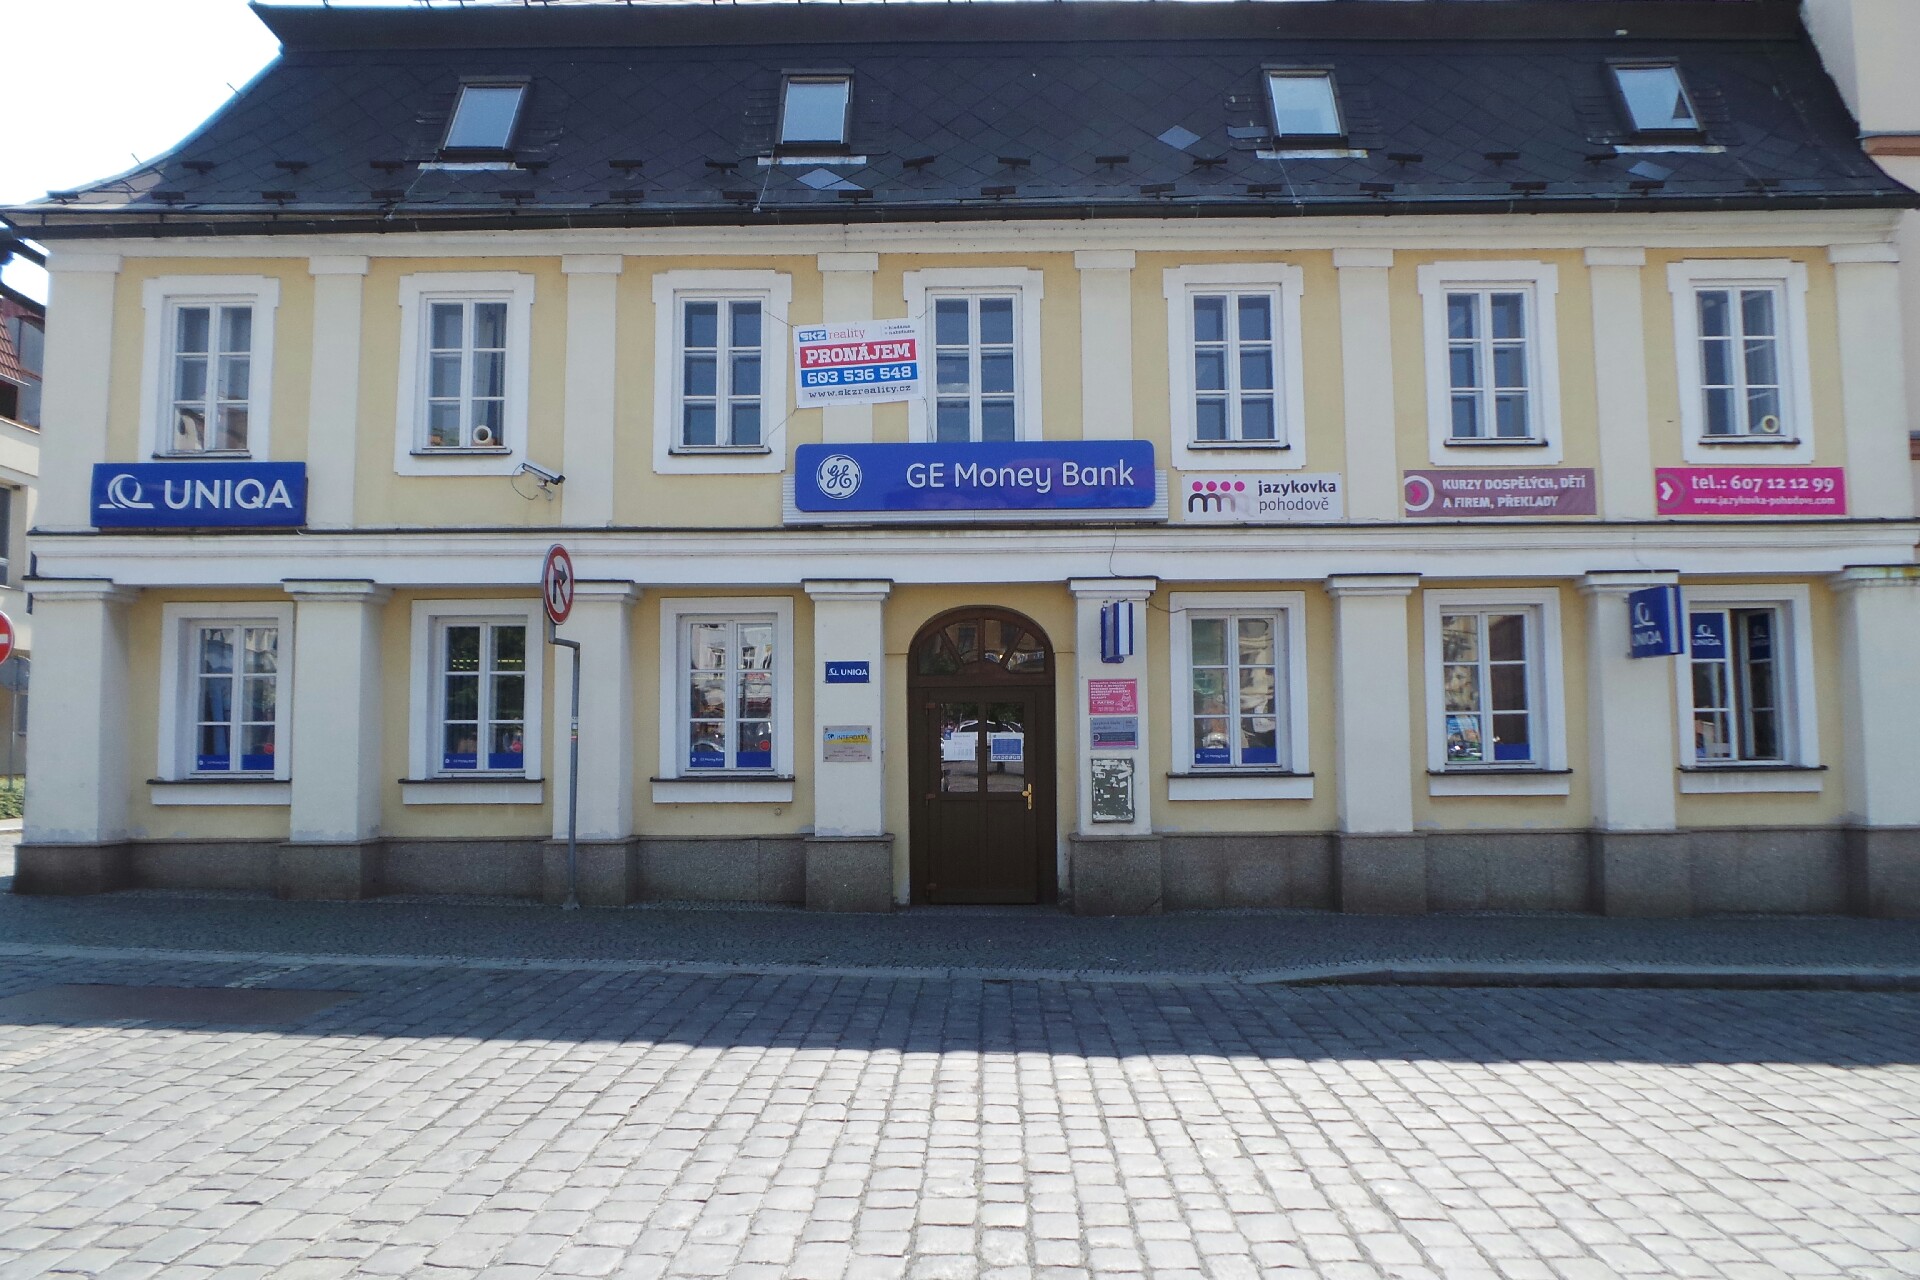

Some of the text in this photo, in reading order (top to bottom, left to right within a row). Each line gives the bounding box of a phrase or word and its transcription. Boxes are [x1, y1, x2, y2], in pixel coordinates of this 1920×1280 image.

[799, 328, 866, 341] SKZ reality
[805, 342, 911, 365] PRONÁJEM
[807, 365, 912, 385] 603 536 548
[808, 384, 912, 399] www.skzreality.cz
[906, 459, 1135, 493] GE Money Bank
[1442, 474, 1586, 491] KURZY DOSPĚLÝCH, DĚTÍ
[1691, 475, 1835, 493] tel.: 607 12 12 99
[164, 478, 293, 510] UNIQA
[1258, 480, 1337, 497] jazykovka
[1259, 497, 1330, 514] pohodově
[1443, 493, 1560, 510] A FIREM, PŘEKLADY
[840, 668, 868, 676] UNIQA
